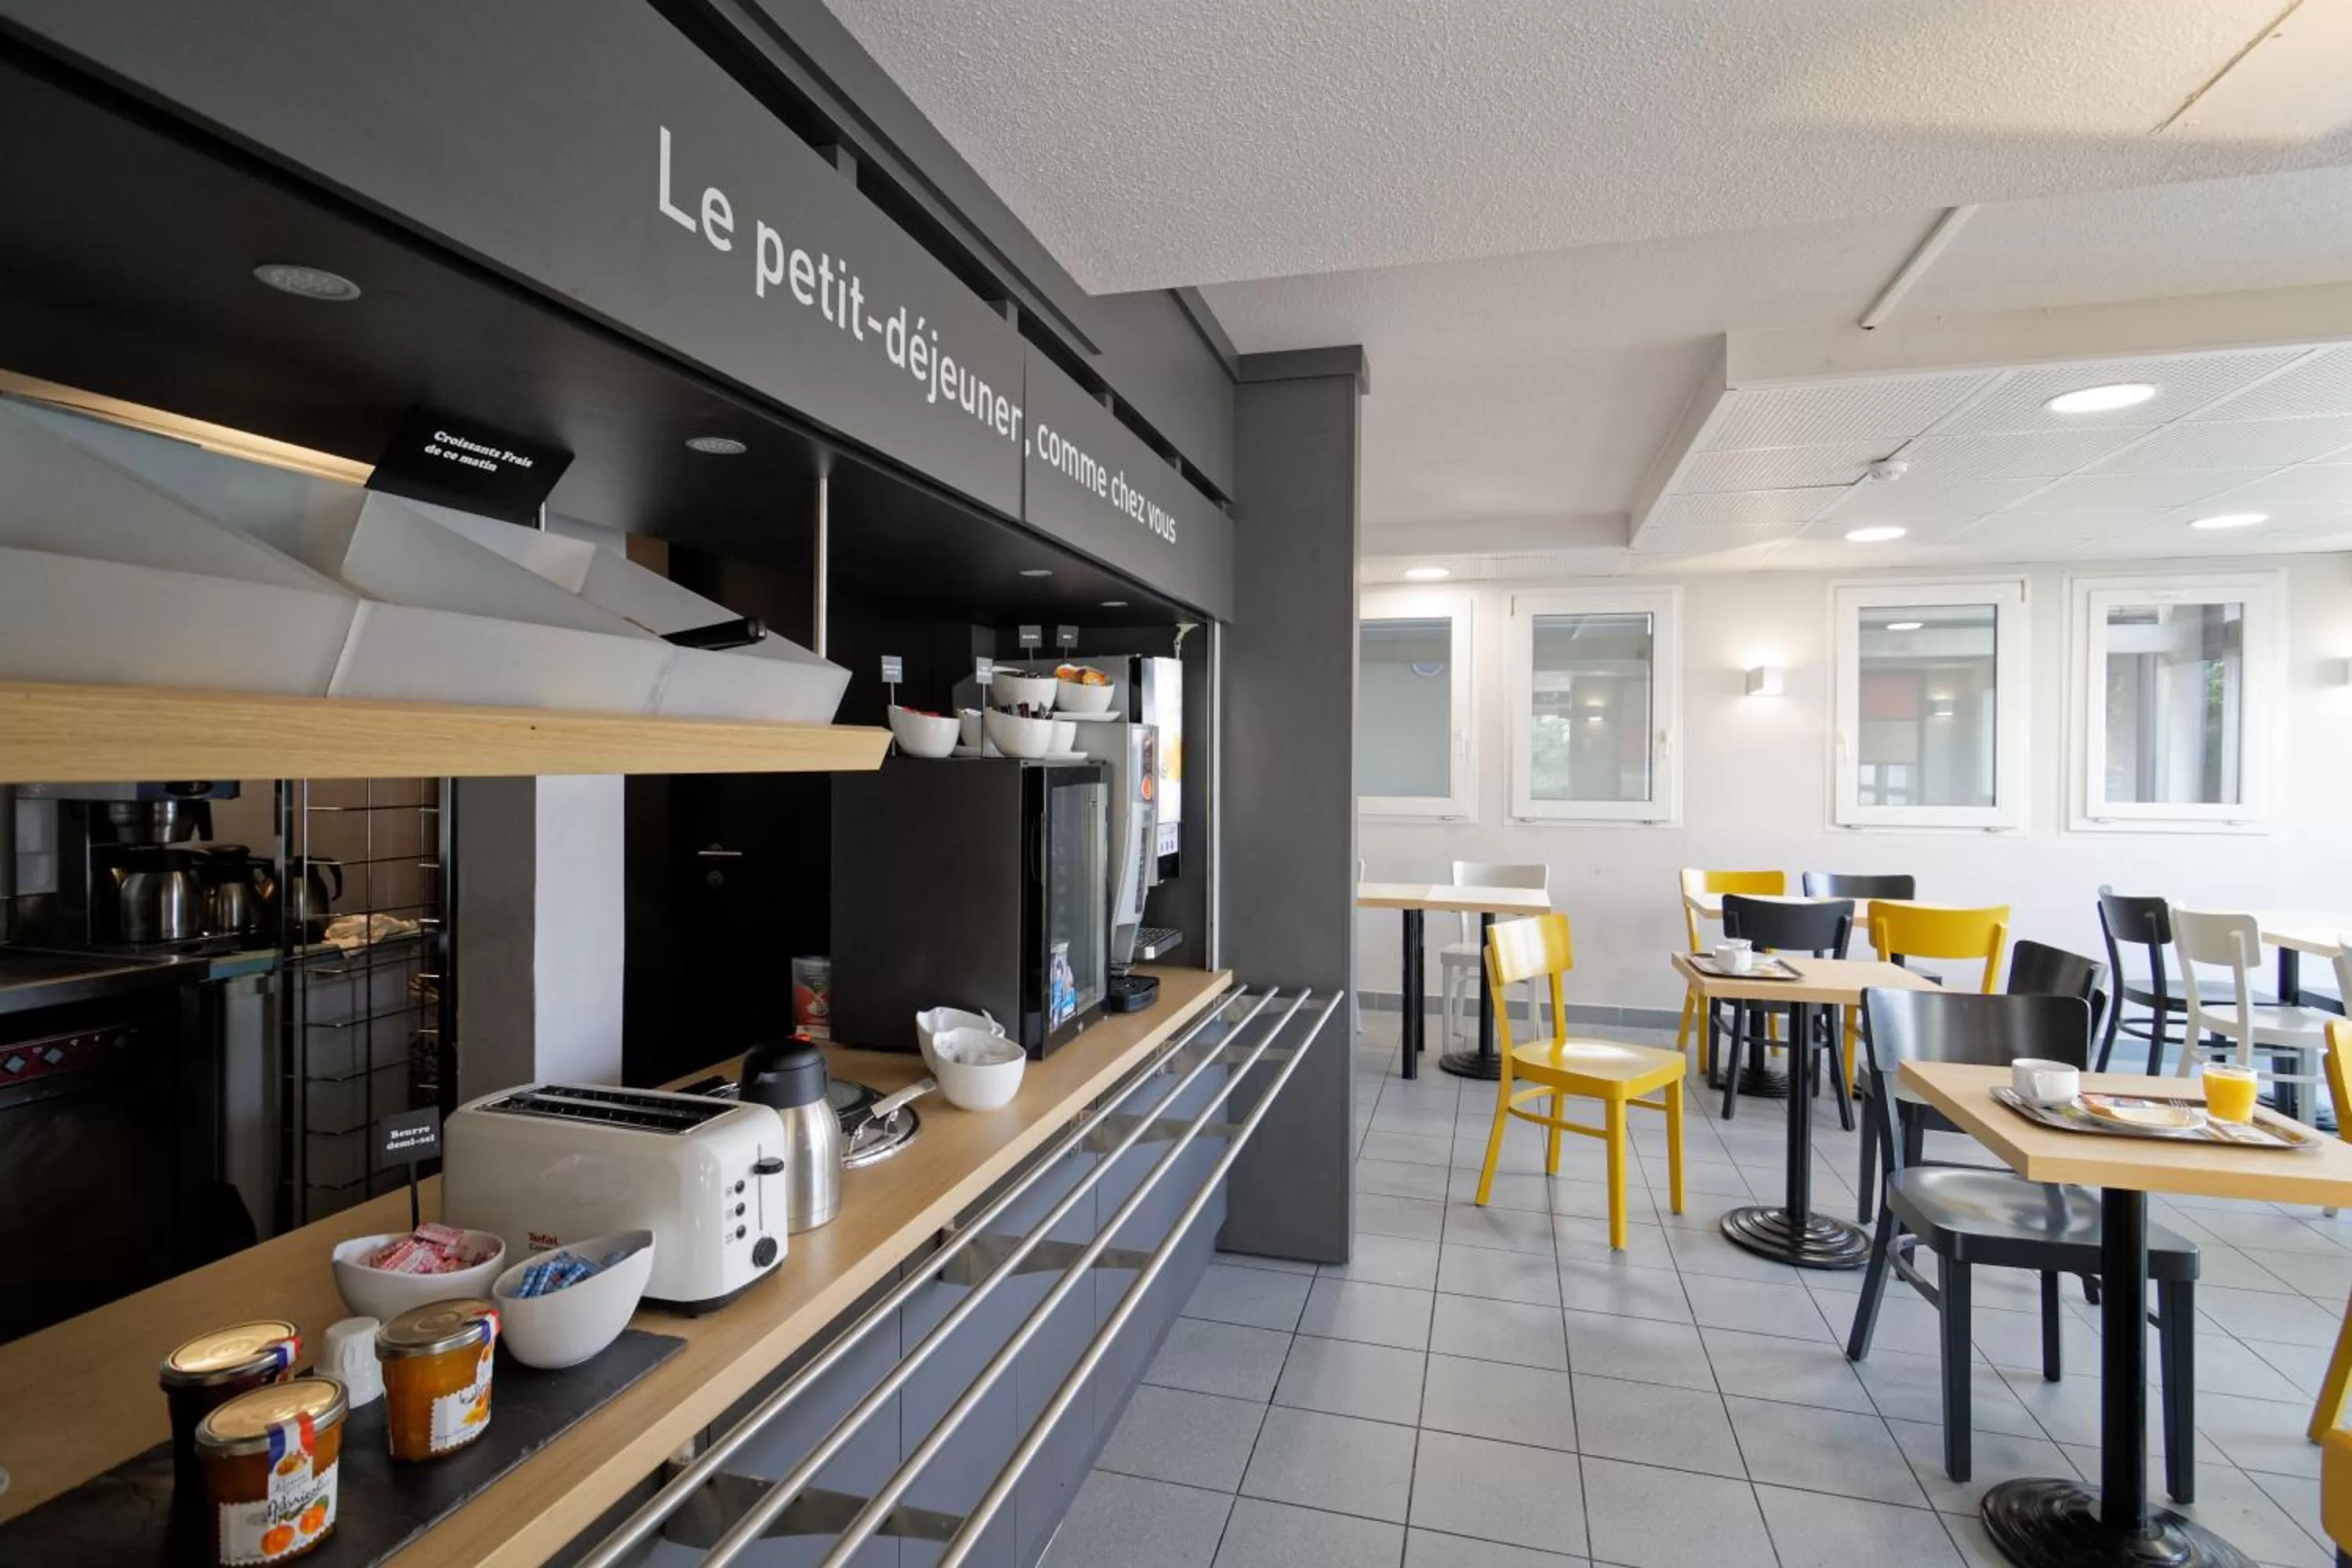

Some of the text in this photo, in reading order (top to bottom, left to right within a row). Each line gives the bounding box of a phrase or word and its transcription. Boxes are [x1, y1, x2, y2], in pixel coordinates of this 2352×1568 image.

[659, 125, 1176, 544] Le petit-déjeuner, comme chez vous
[424, 444, 498, 472] de ce matin
[434, 430, 533, 467] Croissants Frais
[386, 1134, 435, 1150] demi-sel
[390, 1125, 430, 1139] Beurre
